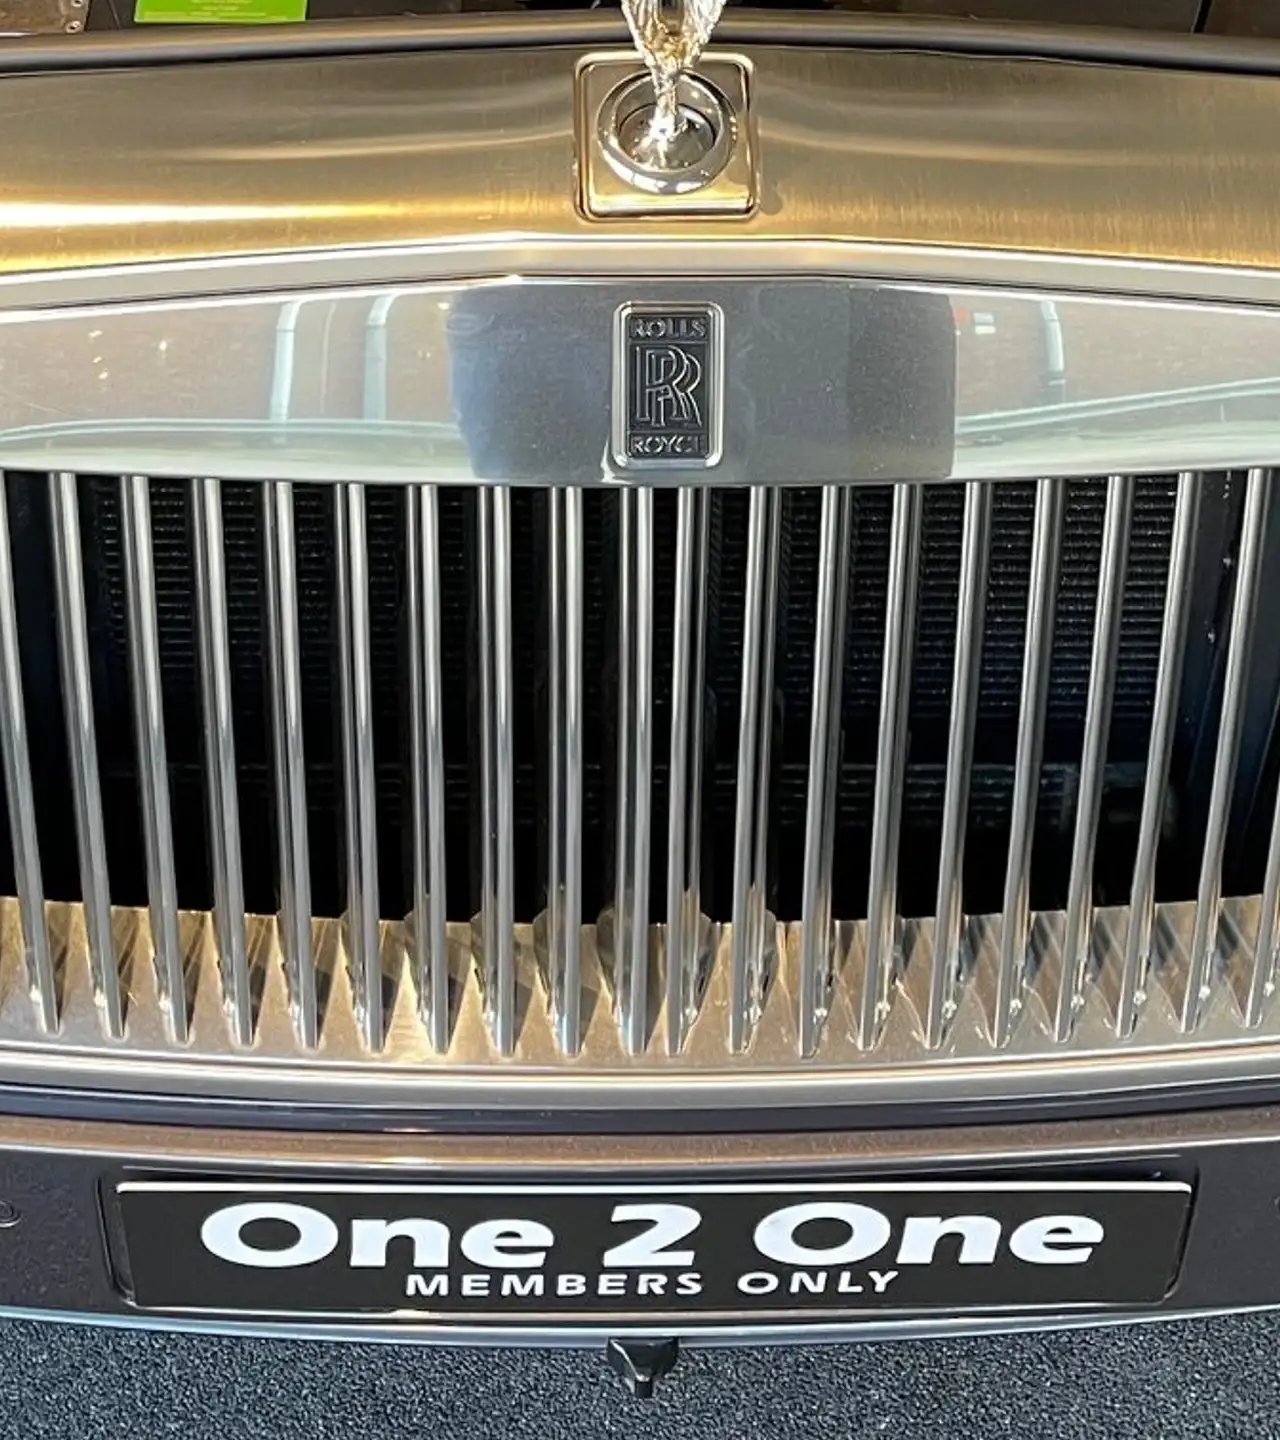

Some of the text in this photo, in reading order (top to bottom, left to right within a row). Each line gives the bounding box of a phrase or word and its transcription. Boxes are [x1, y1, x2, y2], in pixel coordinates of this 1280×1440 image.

[630, 318, 706, 338] ROLLS
[630, 435, 707, 453] ROYCE
[200, 1201, 1105, 1267] One 2 One
[405, 1270, 899, 1297] MEMBERS ONLY
